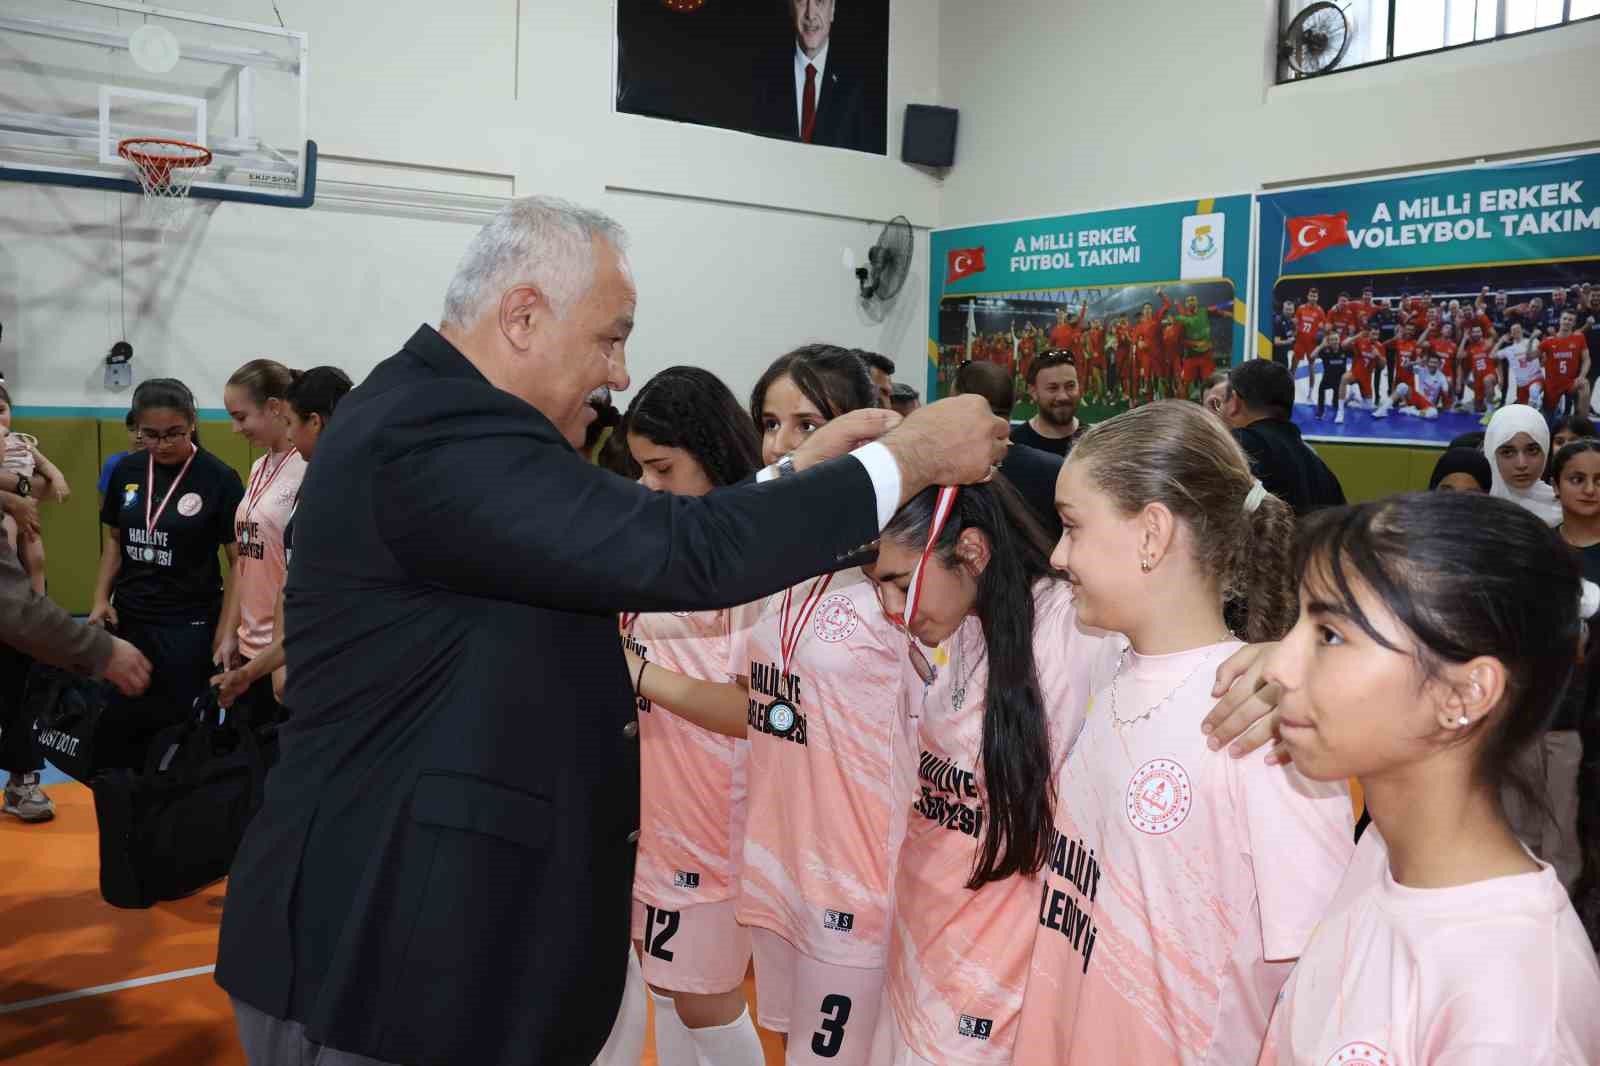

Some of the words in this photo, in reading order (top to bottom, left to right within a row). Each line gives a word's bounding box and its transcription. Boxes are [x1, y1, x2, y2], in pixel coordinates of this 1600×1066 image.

[1371, 203, 1392, 223] A
[1480, 180, 1584, 212] ERKEK
[1014, 237, 1026, 253] A
[1078, 225, 1137, 247] ERKEK
[1347, 218, 1492, 250] VOLEYBOL
[1010, 252, 1074, 272] FUTBOL
[1078, 246, 1140, 267] TAKIMI
[750, 661, 801, 705] HALİLYE
[56, 732, 70, 753] DO
[644, 903, 680, 962] 12
[842, 915, 849, 927] S
[811, 993, 852, 1058] 3
[979, 1021, 988, 1034] S
